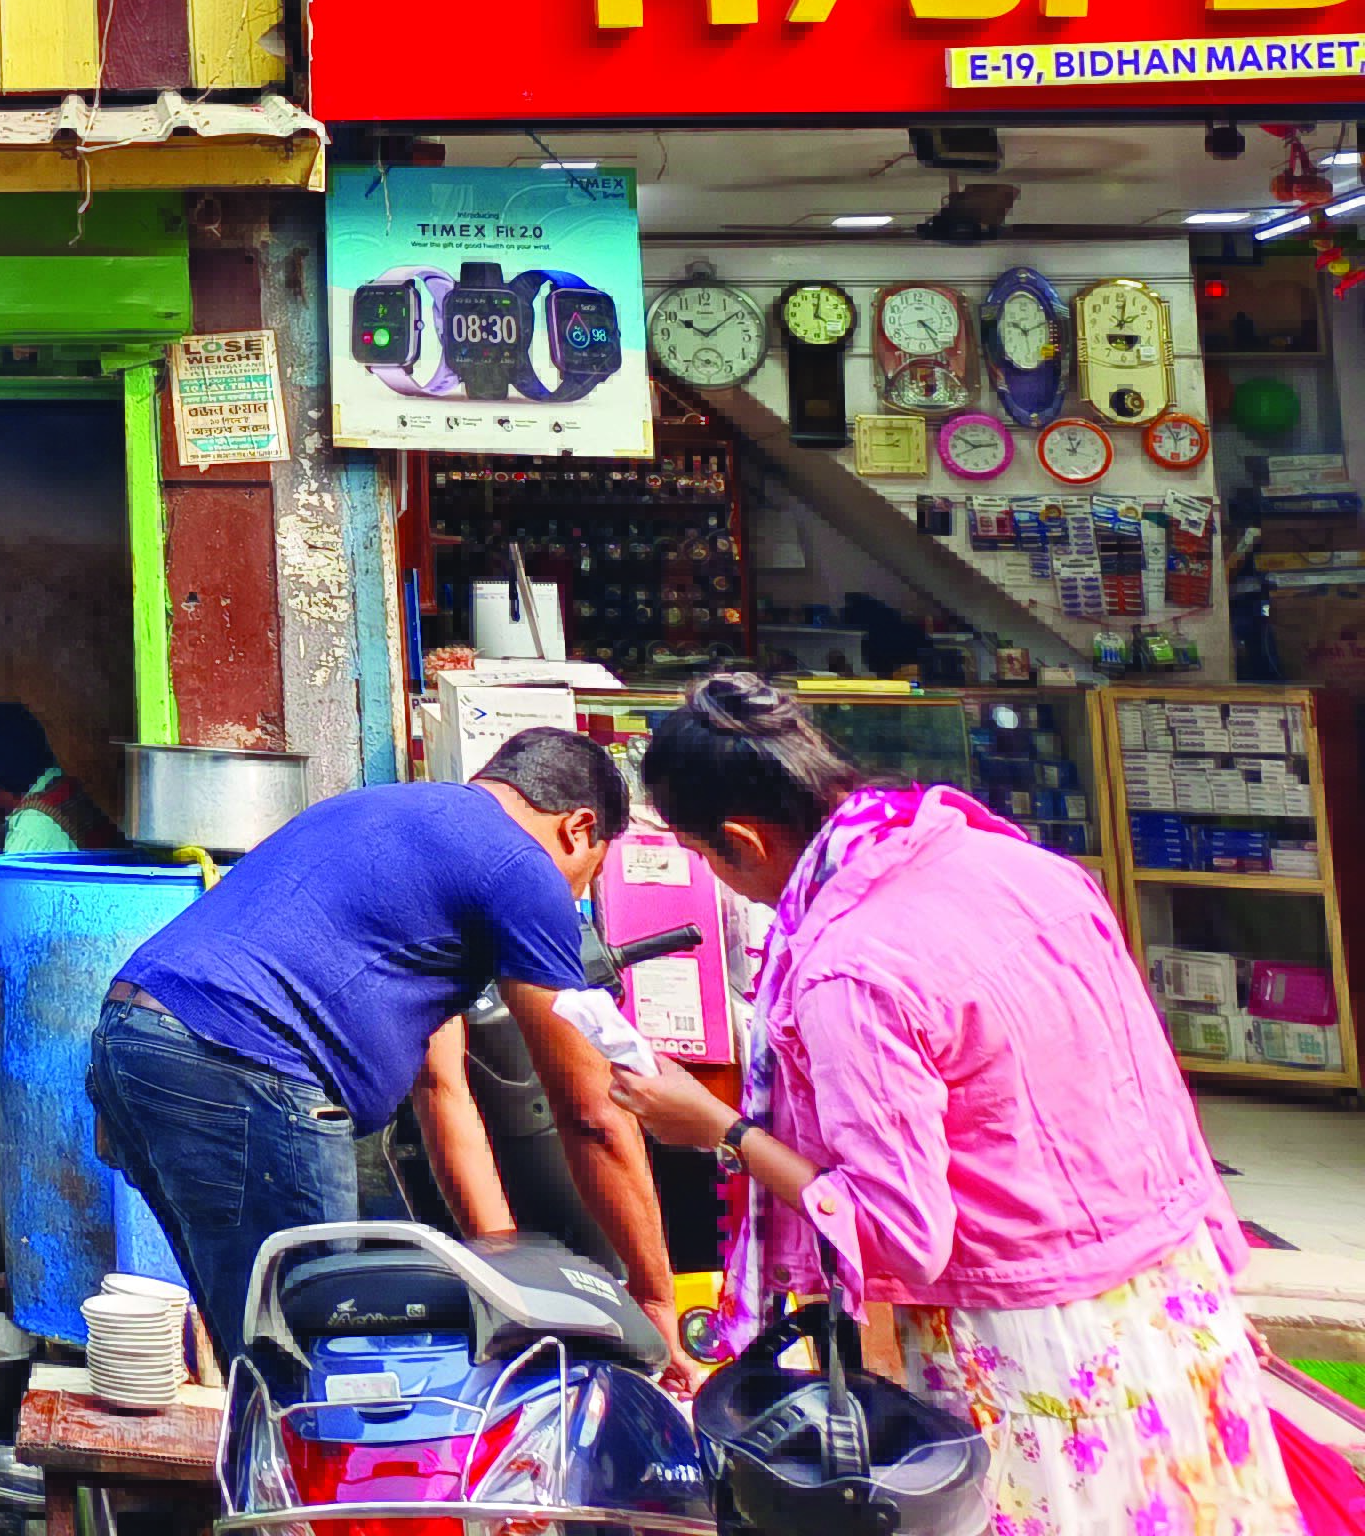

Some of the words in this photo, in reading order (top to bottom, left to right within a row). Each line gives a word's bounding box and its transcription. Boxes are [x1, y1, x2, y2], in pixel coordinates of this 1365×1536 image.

[969, 50, 1045, 86] E-19,
[1054, 45, 1196, 78] BIDHAN
[417, 223, 487, 238] TIMEX
[495, 225, 515, 238] Fit
[519, 225, 544, 239] 2.0
[452, 314, 518, 344] 08:30
[184, 339, 262, 356] LOSE
[186, 353, 264, 365] WEIGHT
